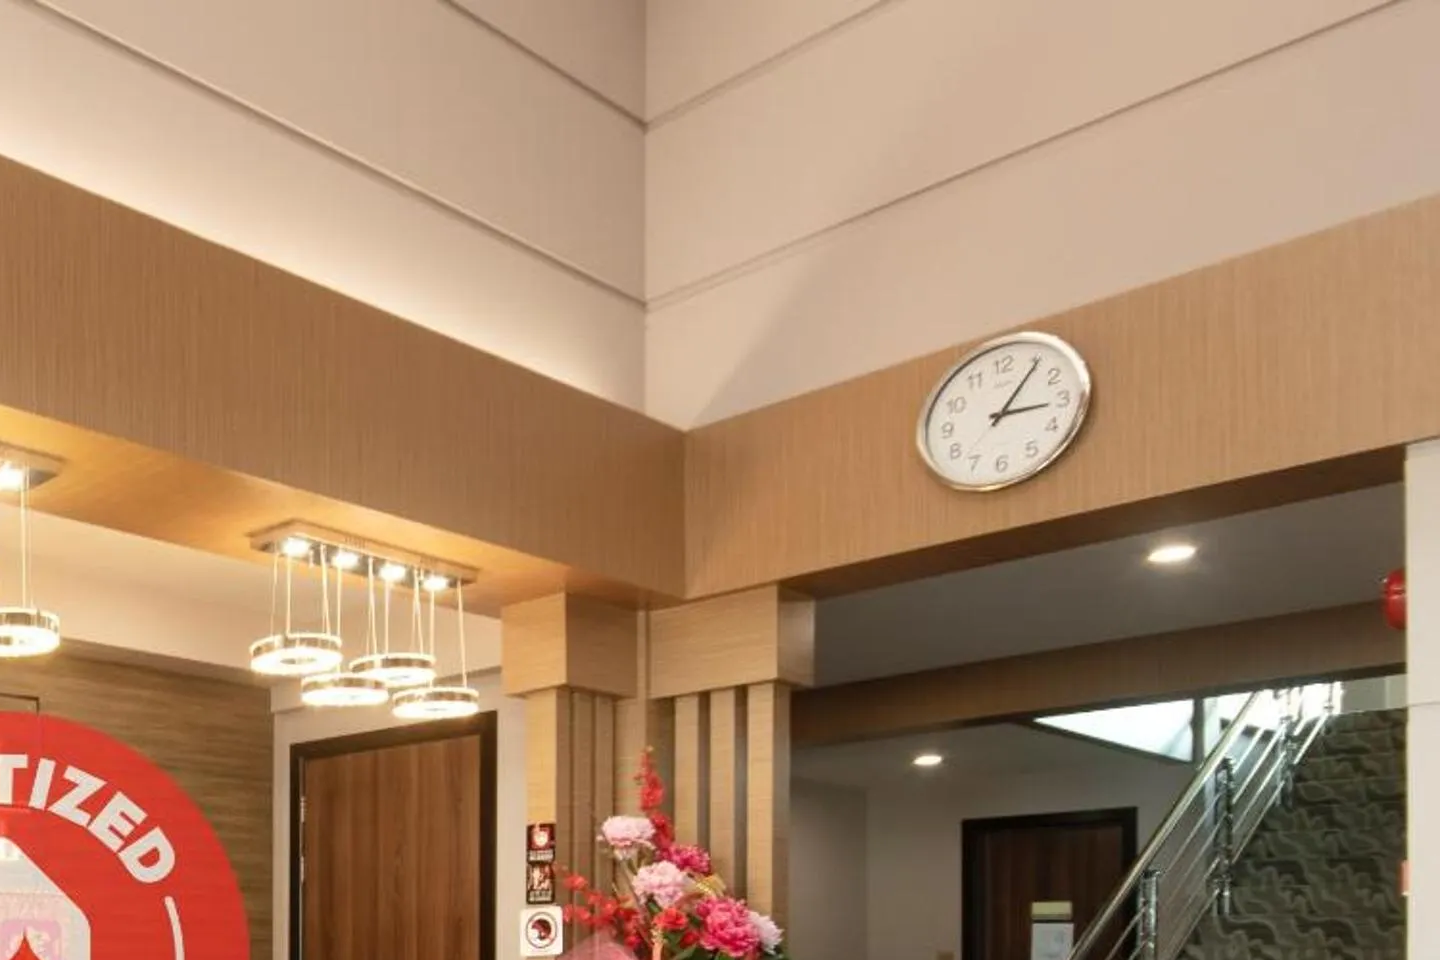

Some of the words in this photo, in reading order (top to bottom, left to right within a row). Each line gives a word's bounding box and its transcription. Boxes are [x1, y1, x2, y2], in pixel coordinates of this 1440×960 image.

[993, 354, 1015, 375] 12
[968, 371, 983, 388] 11
[1047, 367, 1062, 386] 2
[947, 396, 967, 414] 10
[1056, 390, 1071, 407] 3
[941, 422, 955, 439] 9
[1044, 415, 1059, 432] 4
[950, 443, 963, 460] 8
[1025, 440, 1039, 458] 5
[968, 454, 982, 472] 7
[995, 454, 1009, 472] 6
